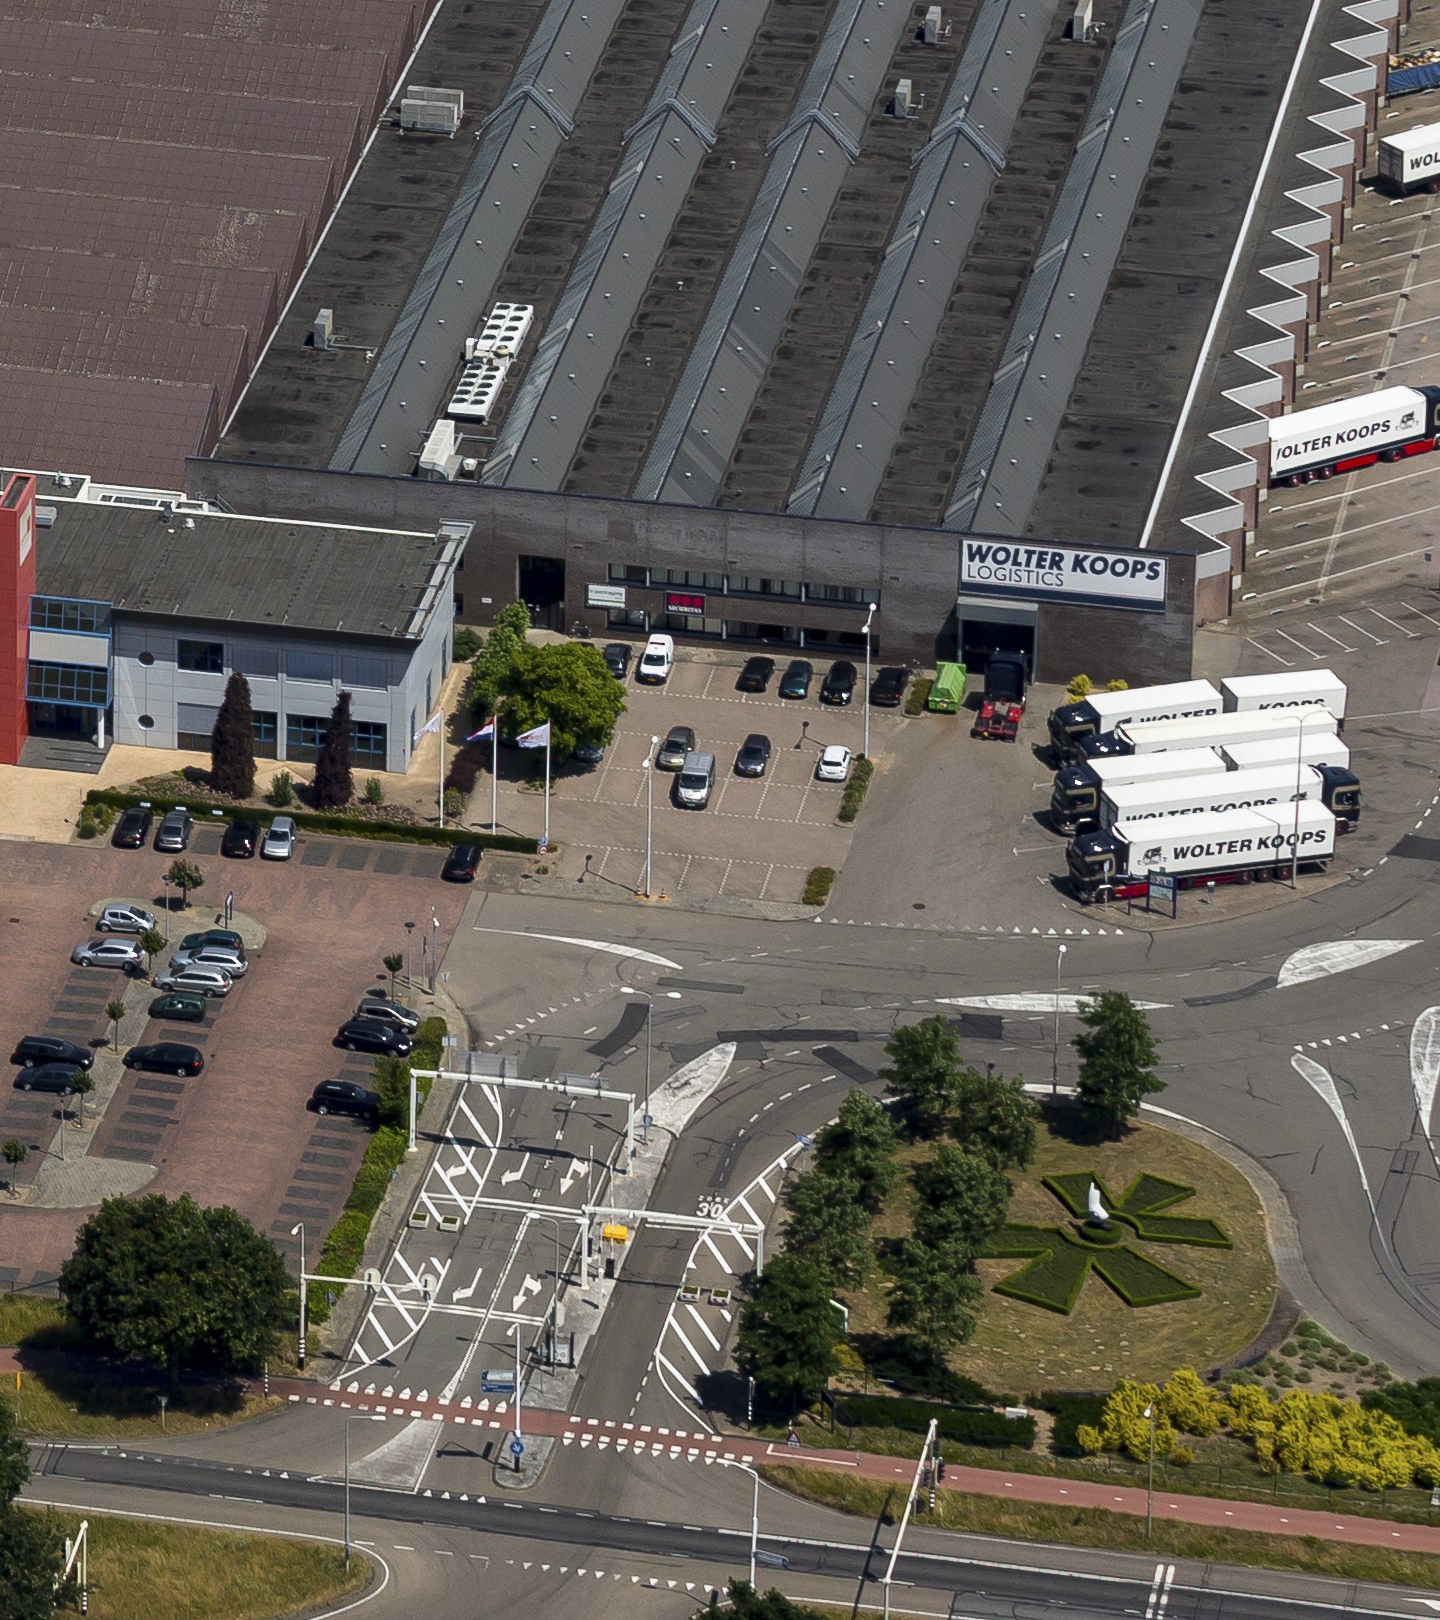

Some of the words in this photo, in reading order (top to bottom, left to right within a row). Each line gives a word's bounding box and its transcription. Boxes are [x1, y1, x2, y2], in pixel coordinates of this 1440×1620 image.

[1276, 434, 1331, 460] OLTER
[1335, 419, 1391, 445] KOOPS
[966, 543, 1065, 571] WOLTER
[1071, 553, 1161, 581] KOOPS
[967, 564, 1064, 587] LOGISTICS
[1173, 838, 1252, 860] WOLTER
[1257, 829, 1327, 851] KOOPS
[696, 1202, 723, 1218] 30
